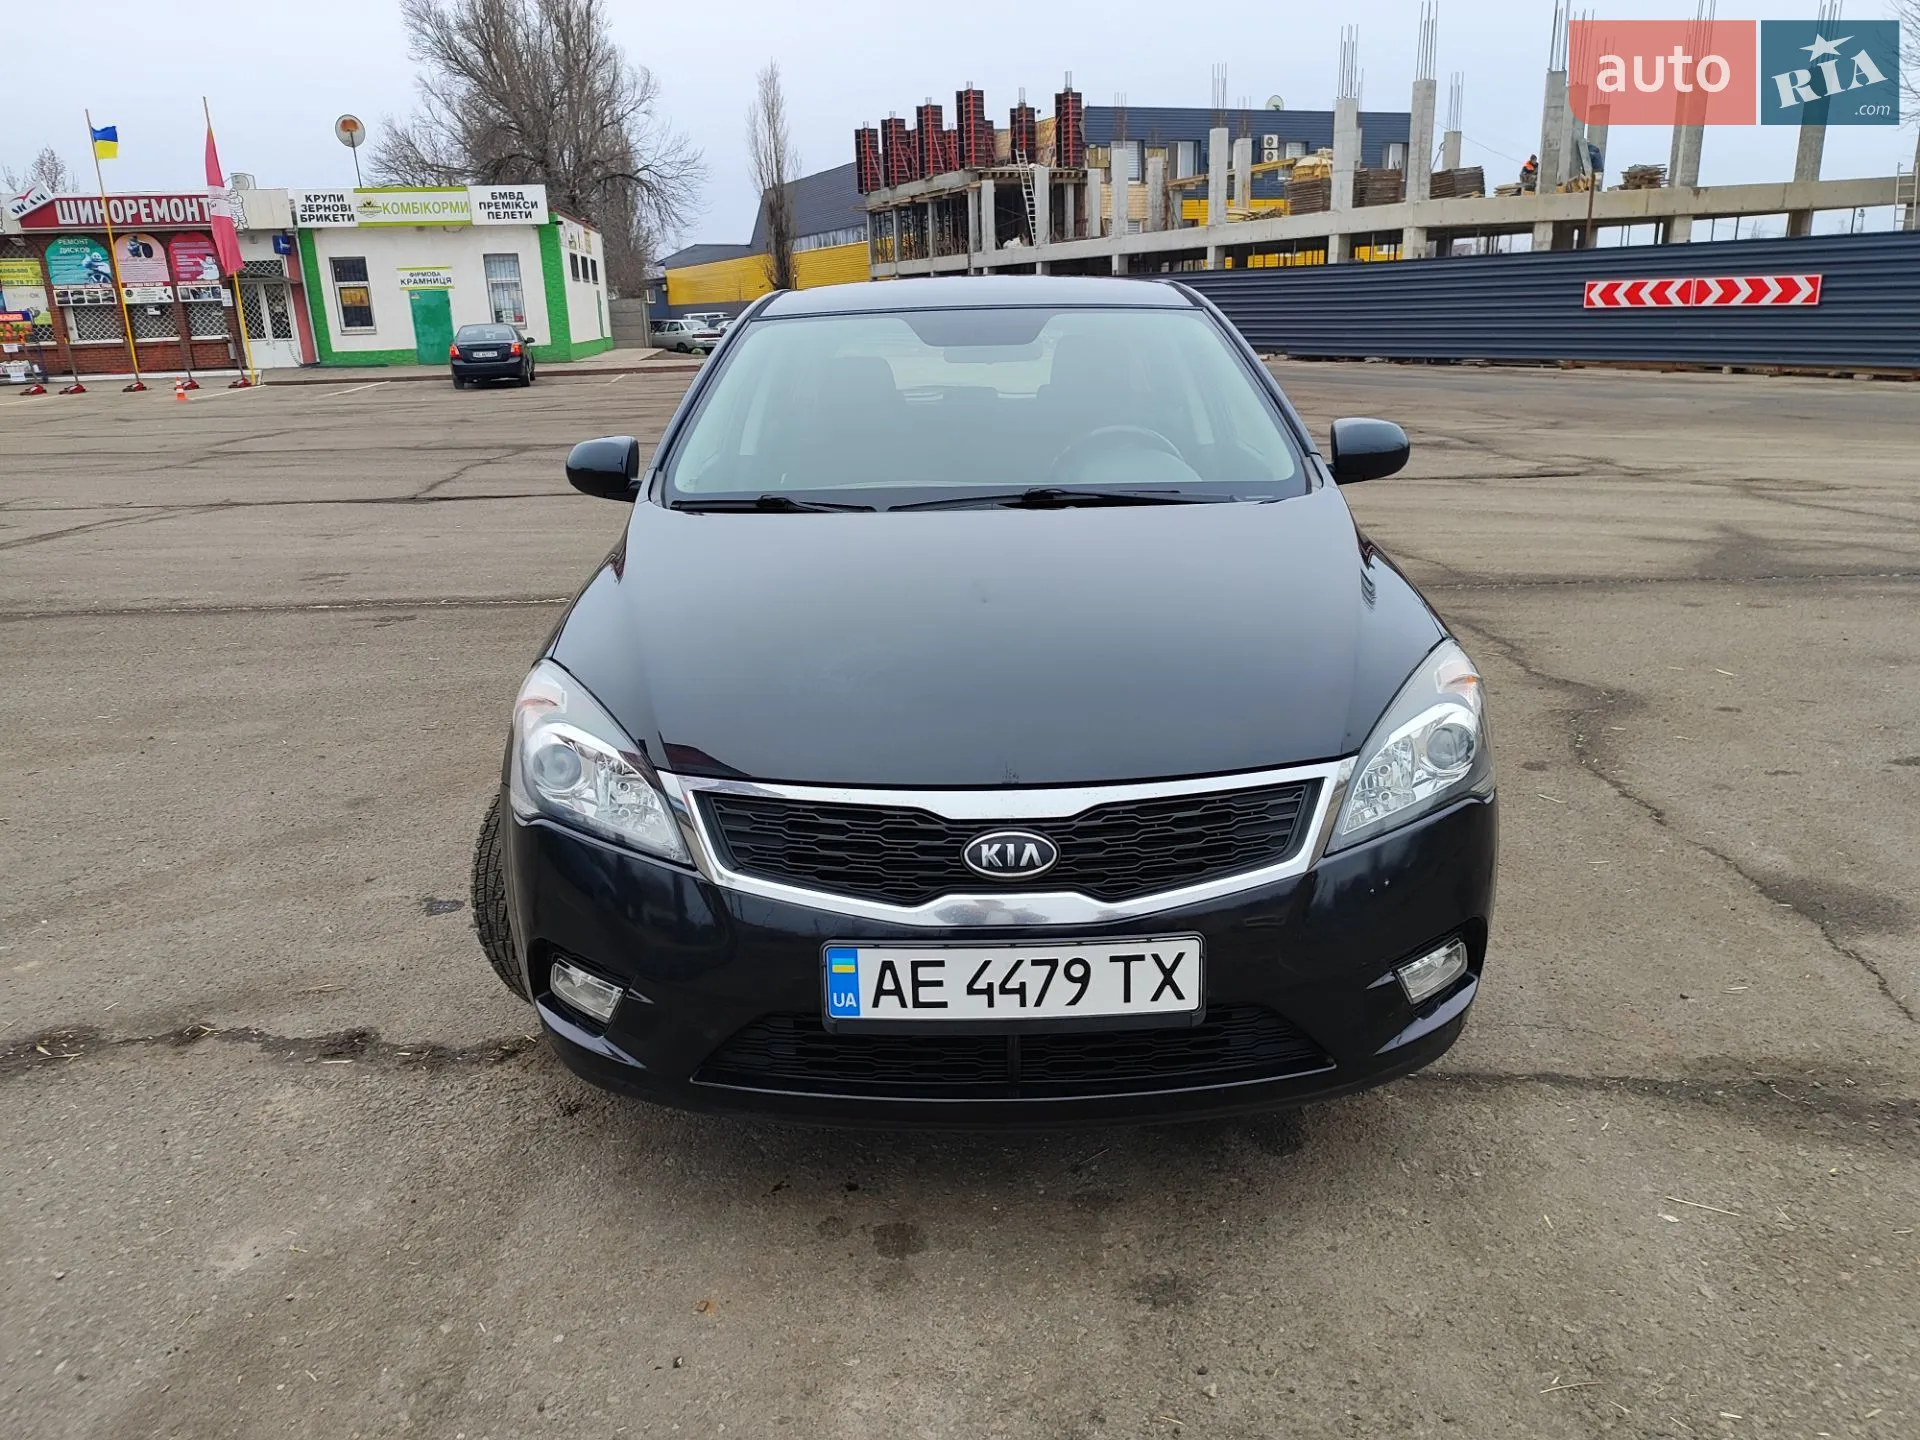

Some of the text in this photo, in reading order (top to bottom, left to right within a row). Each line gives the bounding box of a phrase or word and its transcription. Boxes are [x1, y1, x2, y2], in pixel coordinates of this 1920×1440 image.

[304, 193, 345, 204] КРУПИ
[490, 191, 525, 202] БМВД
[300, 203, 352, 213] ЗЕРНОВІ
[382, 200, 469, 215] КОМБІКОРМИ
[479, 200, 539, 211] ПРЕМІКСИ
[55, 198, 211, 225] ШИНОРЕМОНТ
[487, 210, 533, 220] ПЕЛЕТИ
[300, 213, 355, 223] БРИКЕТИ
[400, 276, 452, 286] КРАМНИЦЯ
[980, 842, 1043, 867] KIA
[871, 951, 1186, 1009] AE 4479 TX
[833, 992, 857, 1008] UA
